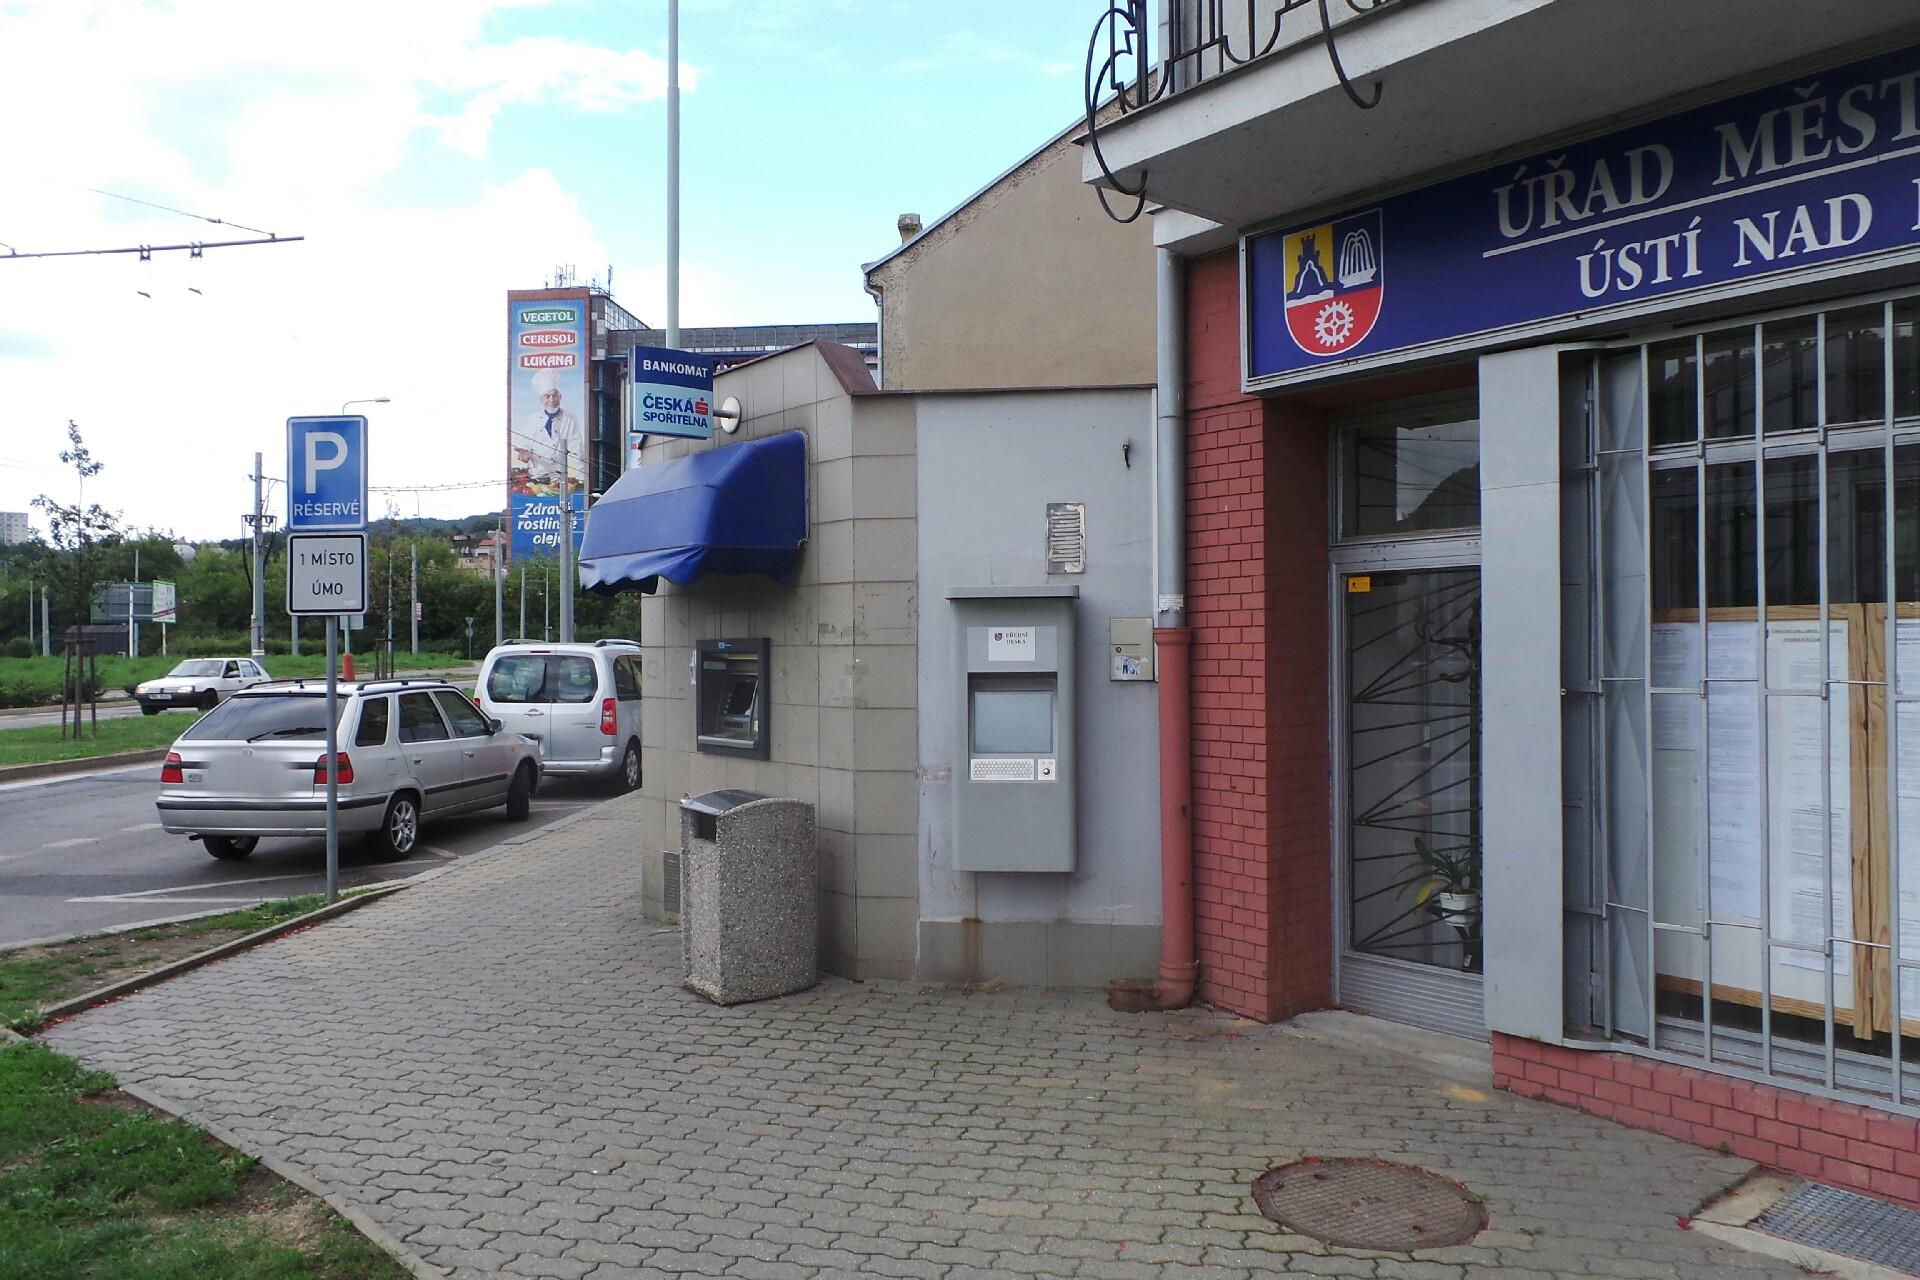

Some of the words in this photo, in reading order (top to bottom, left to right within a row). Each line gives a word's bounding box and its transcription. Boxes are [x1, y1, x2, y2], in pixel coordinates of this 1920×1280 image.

[1493, 144, 1674, 239] ÚŘAD
[1575, 215, 1703, 298] ÚSTÍ
[1732, 193, 1873, 268] NAD
[522, 311, 574, 323] VEGETOL
[522, 334, 574, 345] CERESOL
[523, 355, 573, 367] LUKANA
[643, 359, 709, 379] BANKOMAT
[642, 392, 695, 414] ČESKÁ
[642, 411, 708, 428] SPOŘITELNA
[305, 431, 348, 494] P
[294, 499, 360, 516] RÉSERVÉ
[517, 516, 578, 530] rostliné
[532, 533, 562, 548] olej
[300, 553, 305, 566] 1
[311, 549, 355, 566] MÍSTO
[311, 579, 344, 596] ÚMO
